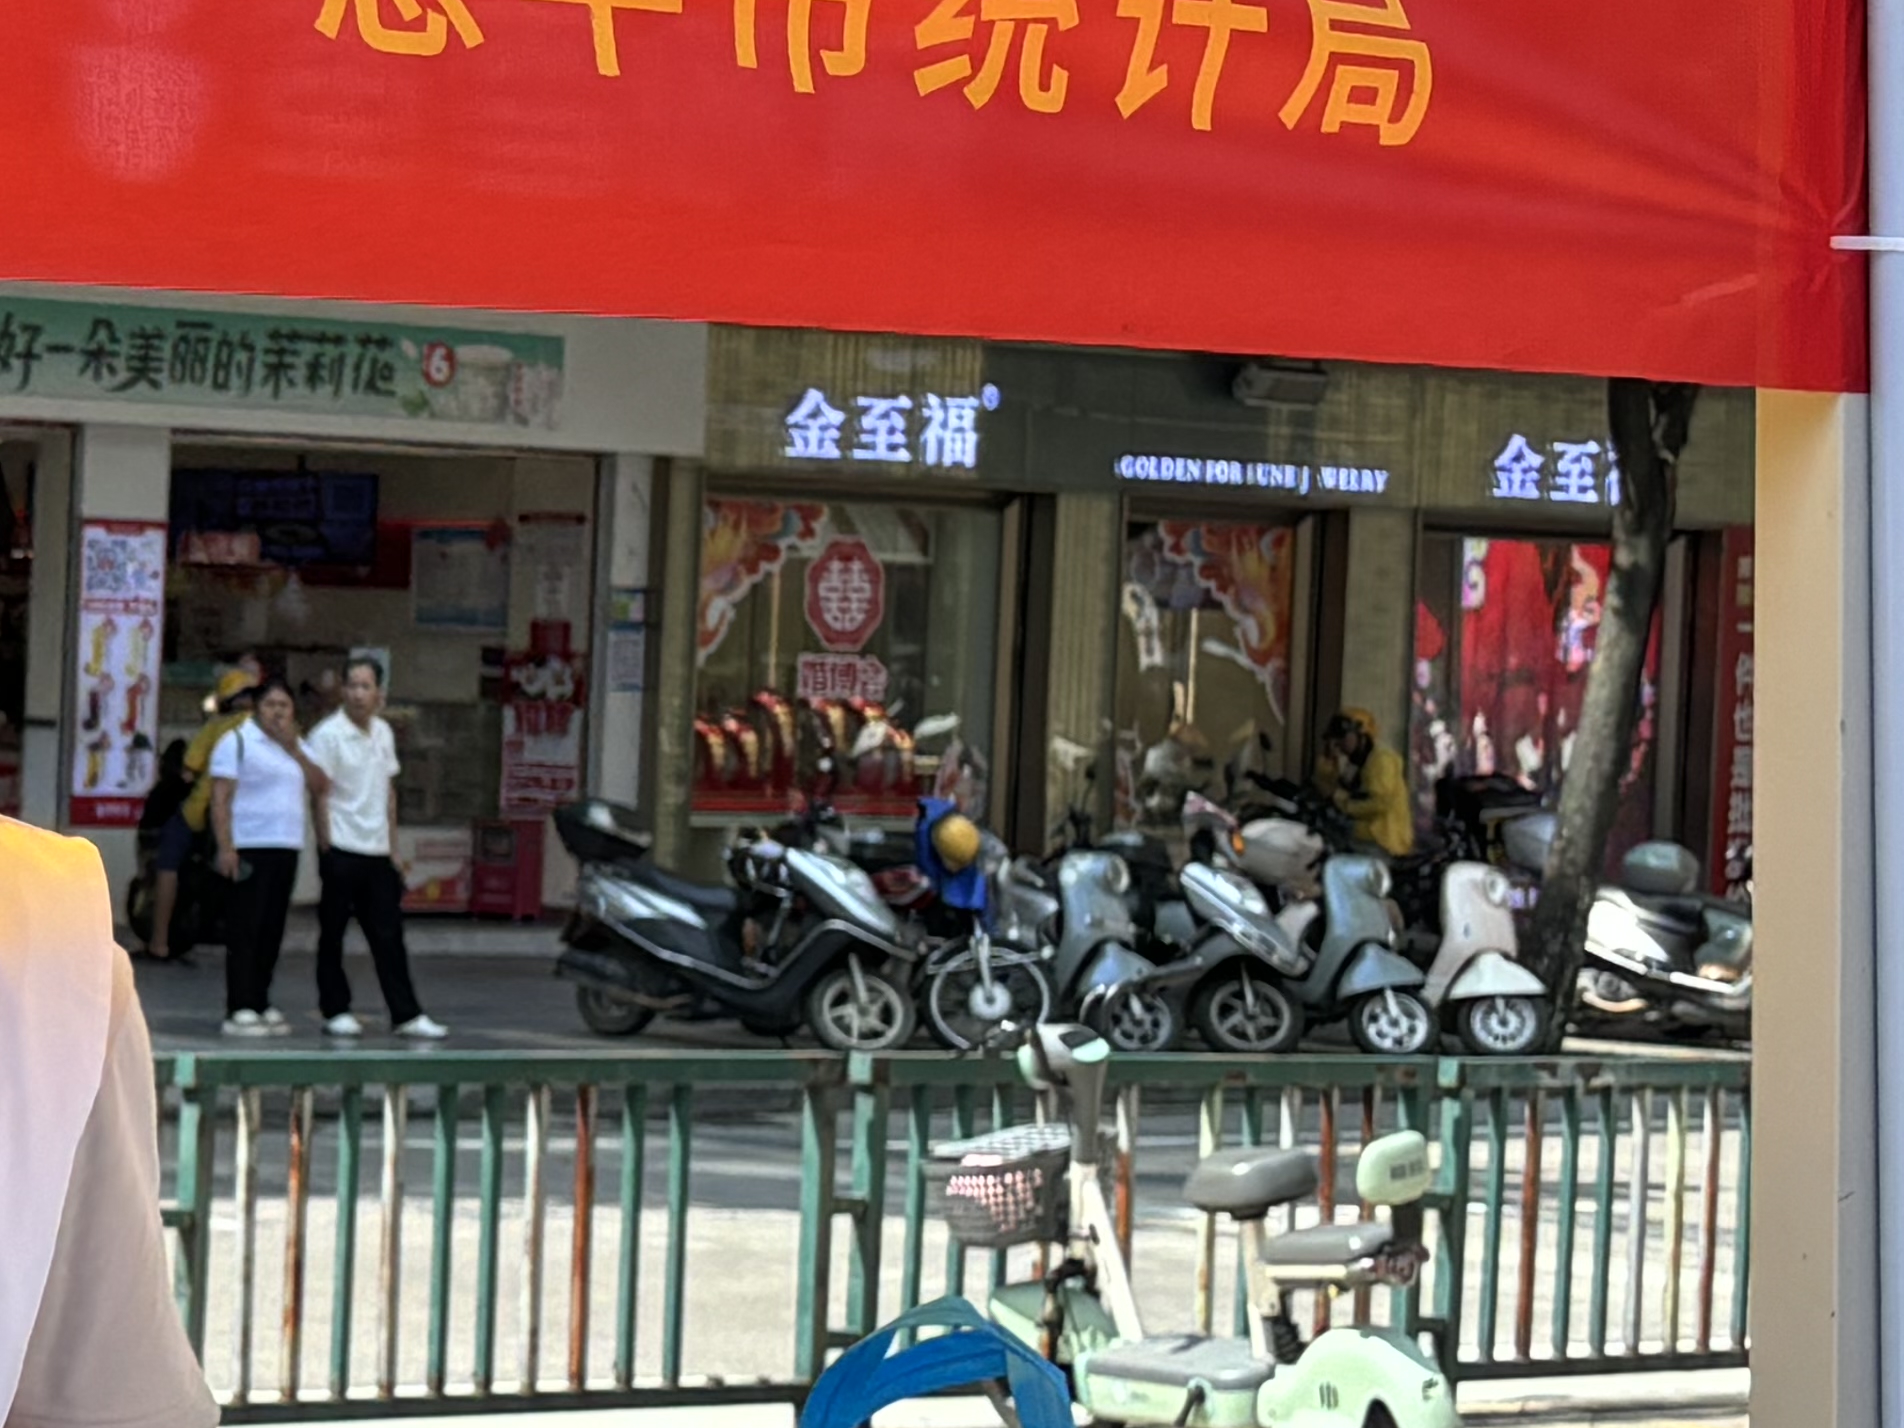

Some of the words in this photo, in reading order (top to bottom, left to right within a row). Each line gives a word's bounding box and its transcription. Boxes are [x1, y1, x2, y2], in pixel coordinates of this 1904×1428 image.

[783, 387, 980, 468] 金至福
[1119, 454, 1202, 482] GOLDEN
